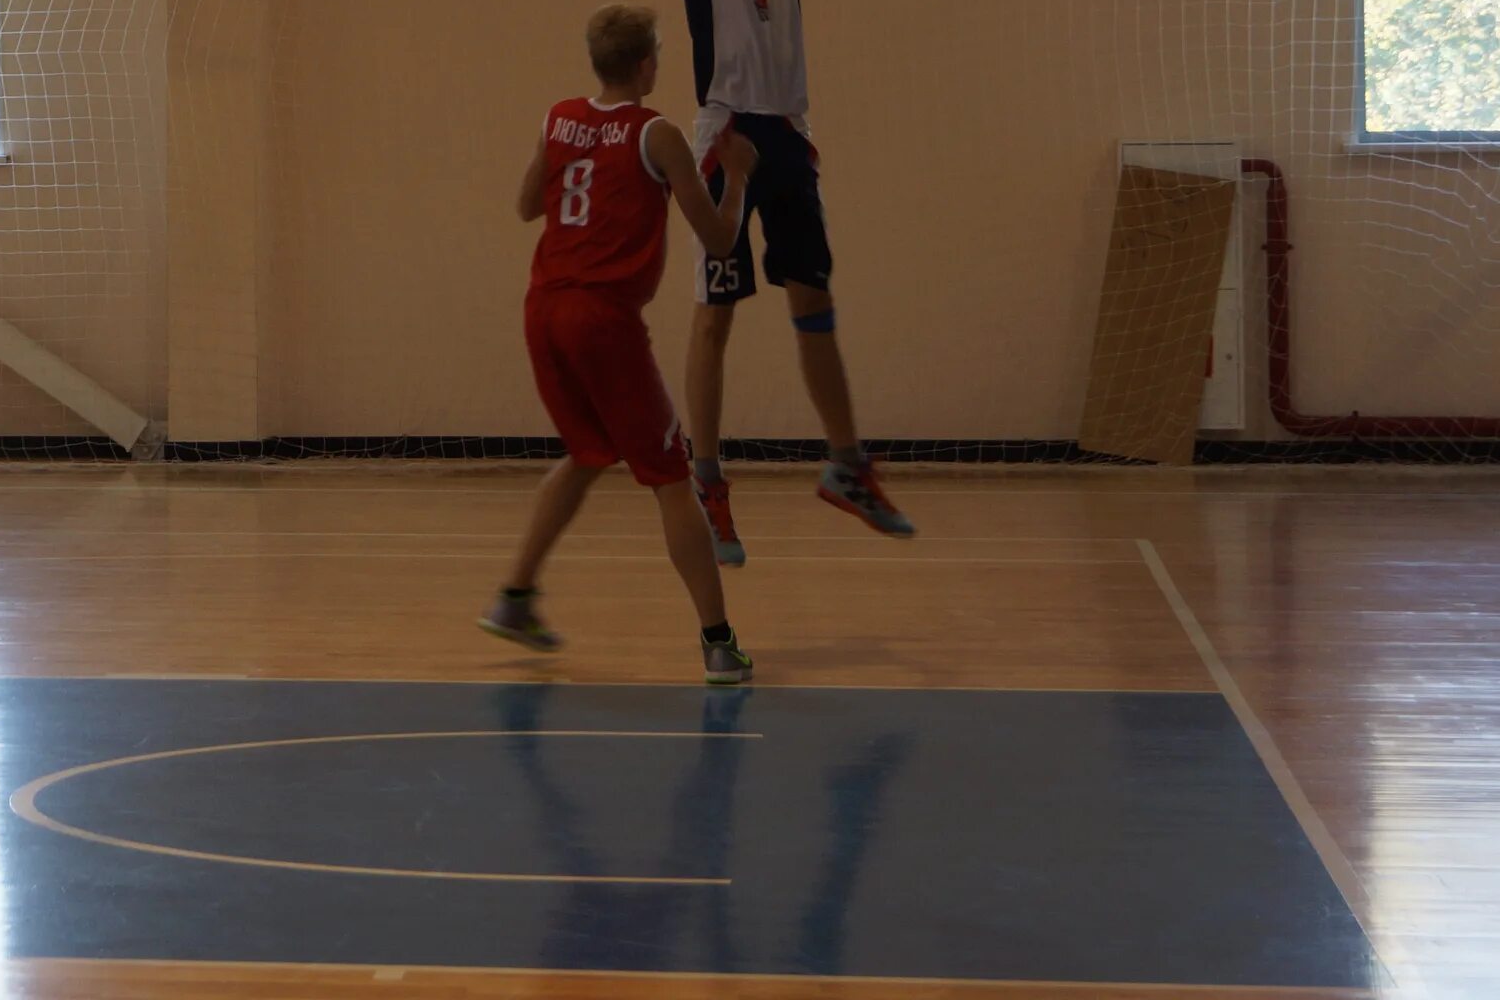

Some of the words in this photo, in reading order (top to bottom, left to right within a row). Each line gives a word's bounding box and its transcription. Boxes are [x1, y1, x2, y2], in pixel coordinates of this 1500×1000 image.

[549, 117, 631, 149] ЛЮБЕЦЫ
[559, 158, 595, 227] 8
[708, 258, 740, 294] 25
